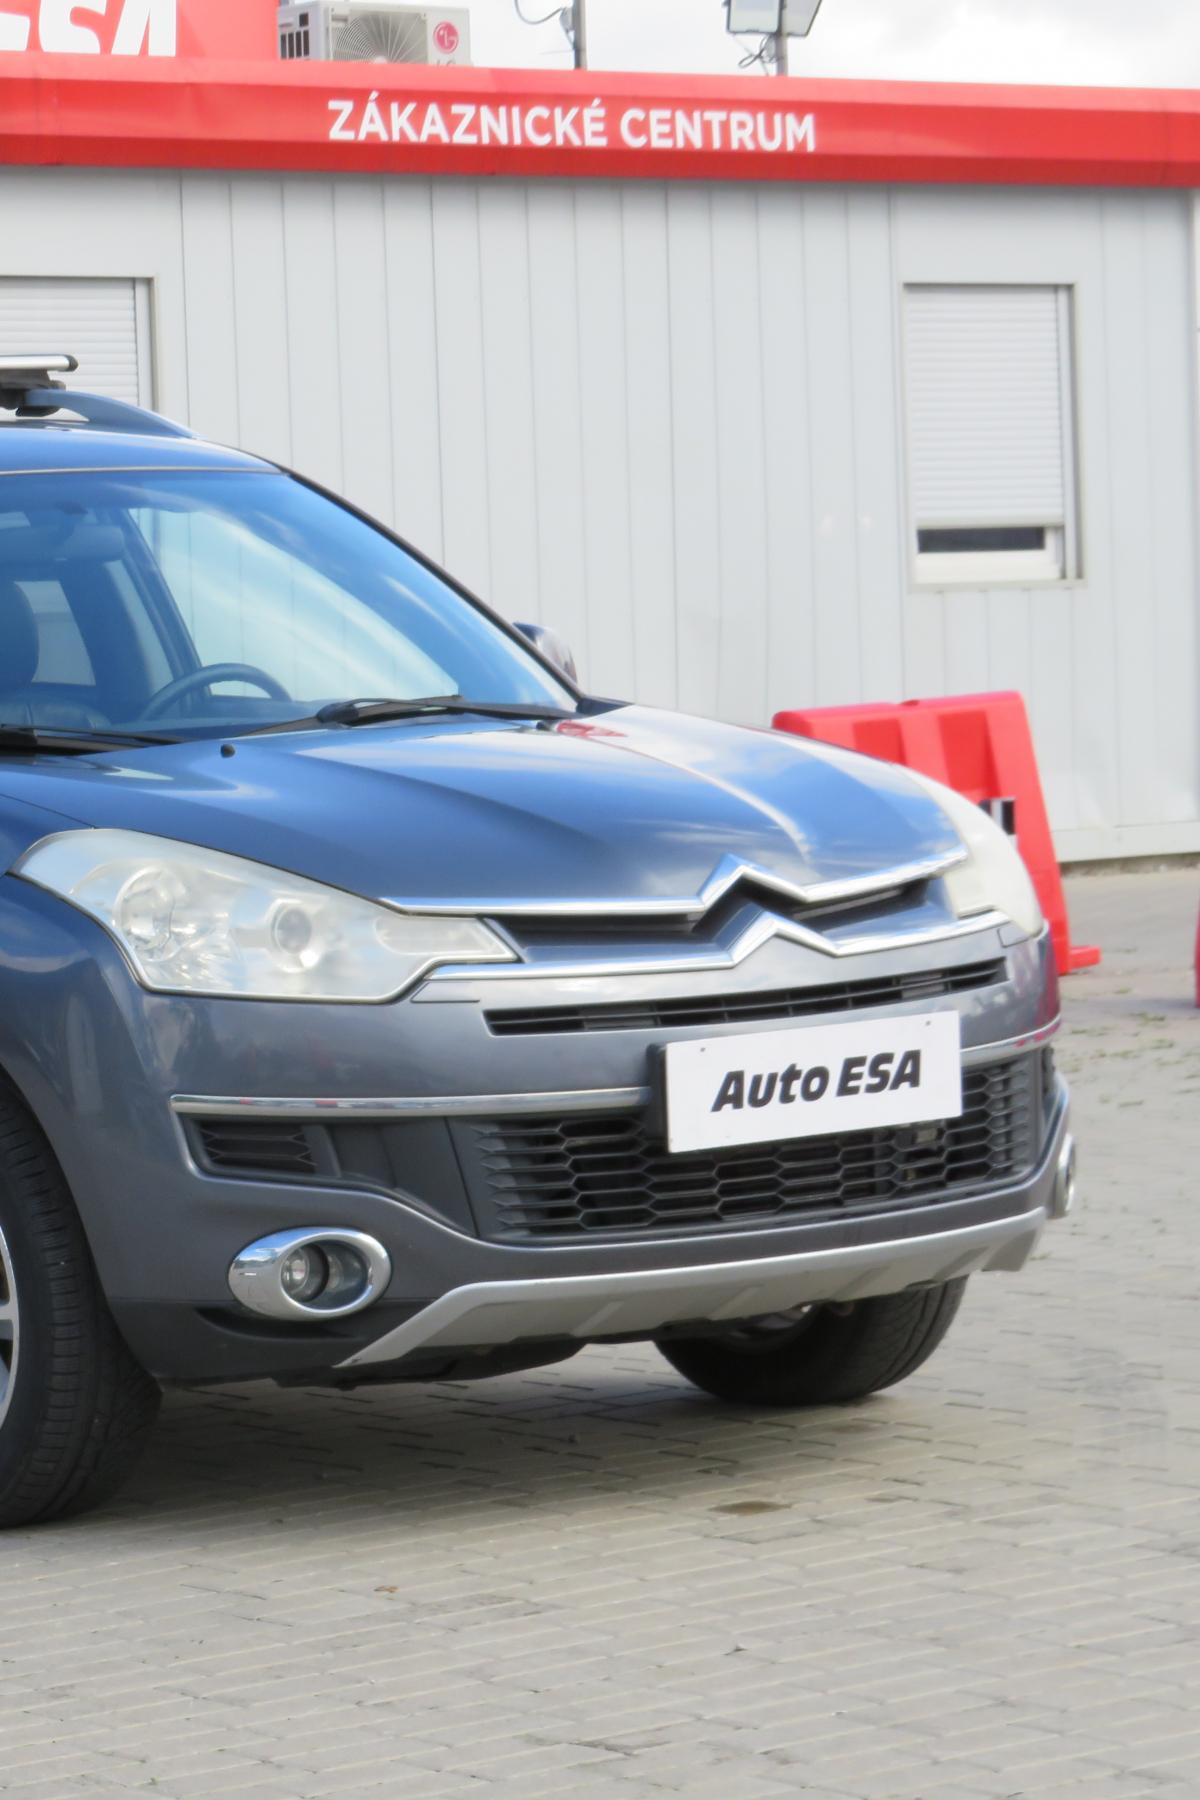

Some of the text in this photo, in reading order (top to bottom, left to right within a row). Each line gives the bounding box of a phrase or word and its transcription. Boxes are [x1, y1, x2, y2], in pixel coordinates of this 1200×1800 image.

[327, 91, 815, 152] ZÁKAZNICKÉ CENTRUM
[710, 1049, 922, 1113] Auto ESA
